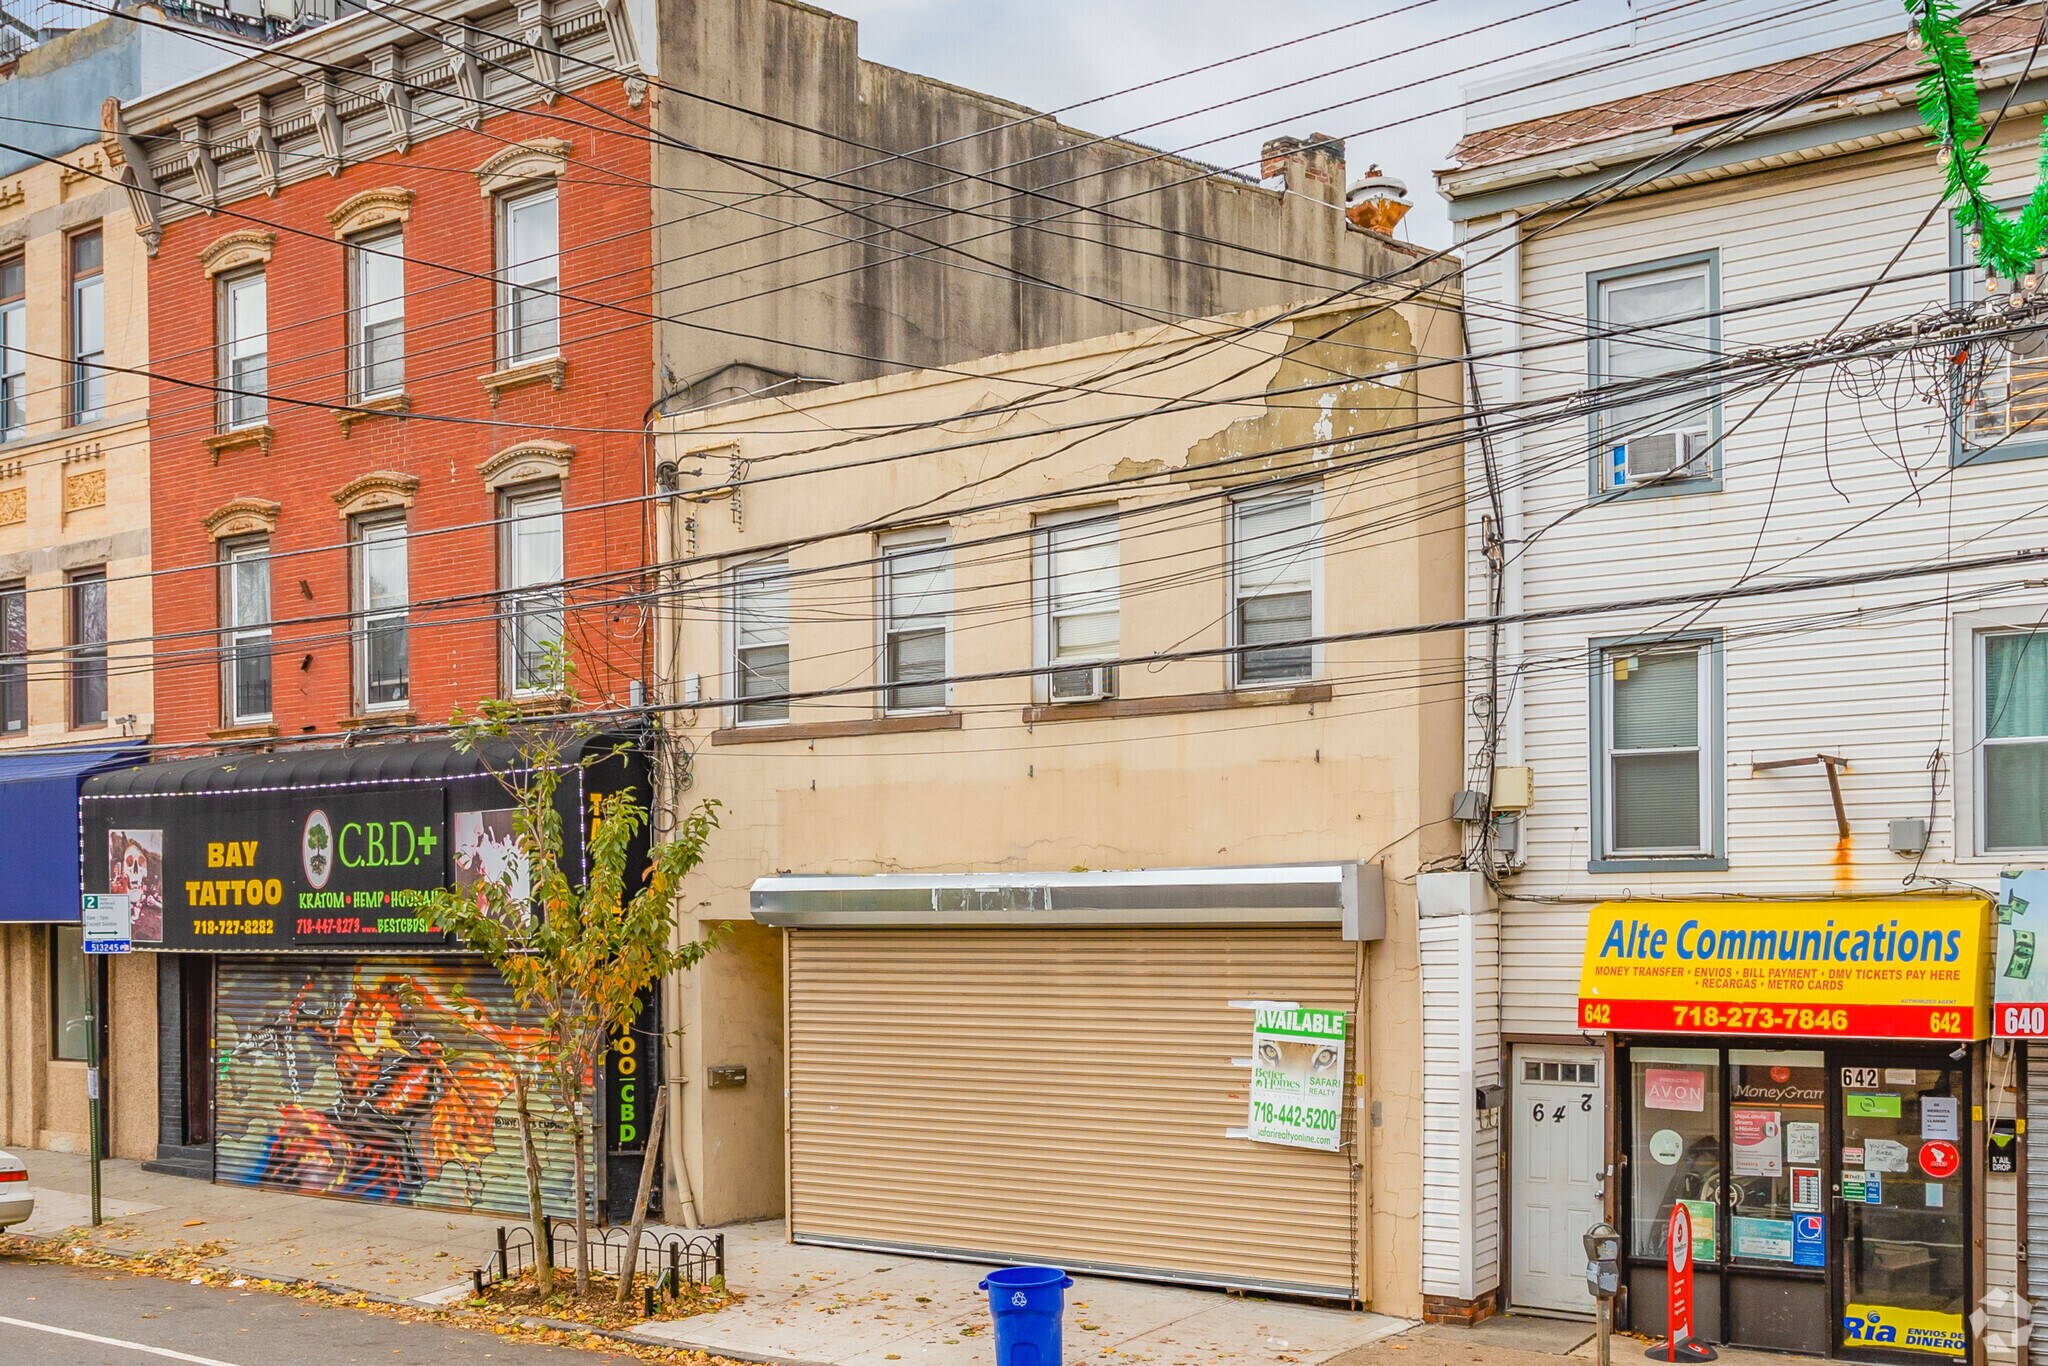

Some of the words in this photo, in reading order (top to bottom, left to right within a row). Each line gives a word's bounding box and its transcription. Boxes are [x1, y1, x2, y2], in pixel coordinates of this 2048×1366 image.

[207, 840, 258, 868] BAY
[185, 878, 282, 906] TATTOO
[87, 896, 95, 908] 2
[299, 892, 345, 909] KRATOM
[353, 891, 384, 908] HEMP
[296, 917, 361, 934] 718-447-8273
[91, 943, 119, 951] 513245
[1599, 919, 1668, 959] Alte
[1676, 919, 1961, 962] Communications
[1595, 966, 1630, 976] MONEY
[1633, 966, 1684, 977] TRANSFER
[1694, 967, 1732, 978] ENVIOS
[1743, 967, 1765, 978] BILL
[1768, 968, 1818, 979] PAYMENT
[1829, 969, 1852, 979] DMV
[1856, 969, 1902, 980] TICKETS
[1906, 970, 1927, 980] PAY
[1930, 970, 1960, 980] HERE
[1702, 978, 1757, 989] RECARGAS
[1768, 979, 1804, 990] METRO
[1808, 980, 1844, 990] CARDS
[1257, 1009, 1343, 1035] AVAILABLE
[1584, 1003, 1610, 1024] 642
[1672, 1005, 1848, 1031] 718-273-7846
[1930, 1011, 1961, 1034] 642
[2004, 1007, 2045, 1035] 640
[1255, 1067, 1285, 1080] Better
[1843, 1068, 1877, 1086] 642
[1264, 1078, 1301, 1090] Homes
[1309, 1077, 1341, 1088] SAFARI
[1308, 1087, 1336, 1097] REALTY
[1649, 1084, 1701, 1100] AVON
[1253, 1101, 1337, 1131] 718-442-5200
[1992, 1163, 2011, 1171] DROP
[1843, 1310, 1897, 1343] Ria
[1907, 1327, 1947, 1338] ENVIOS
[1905, 1335, 1965, 1350] DINERO
[1950, 1331, 1964, 1340] DE
